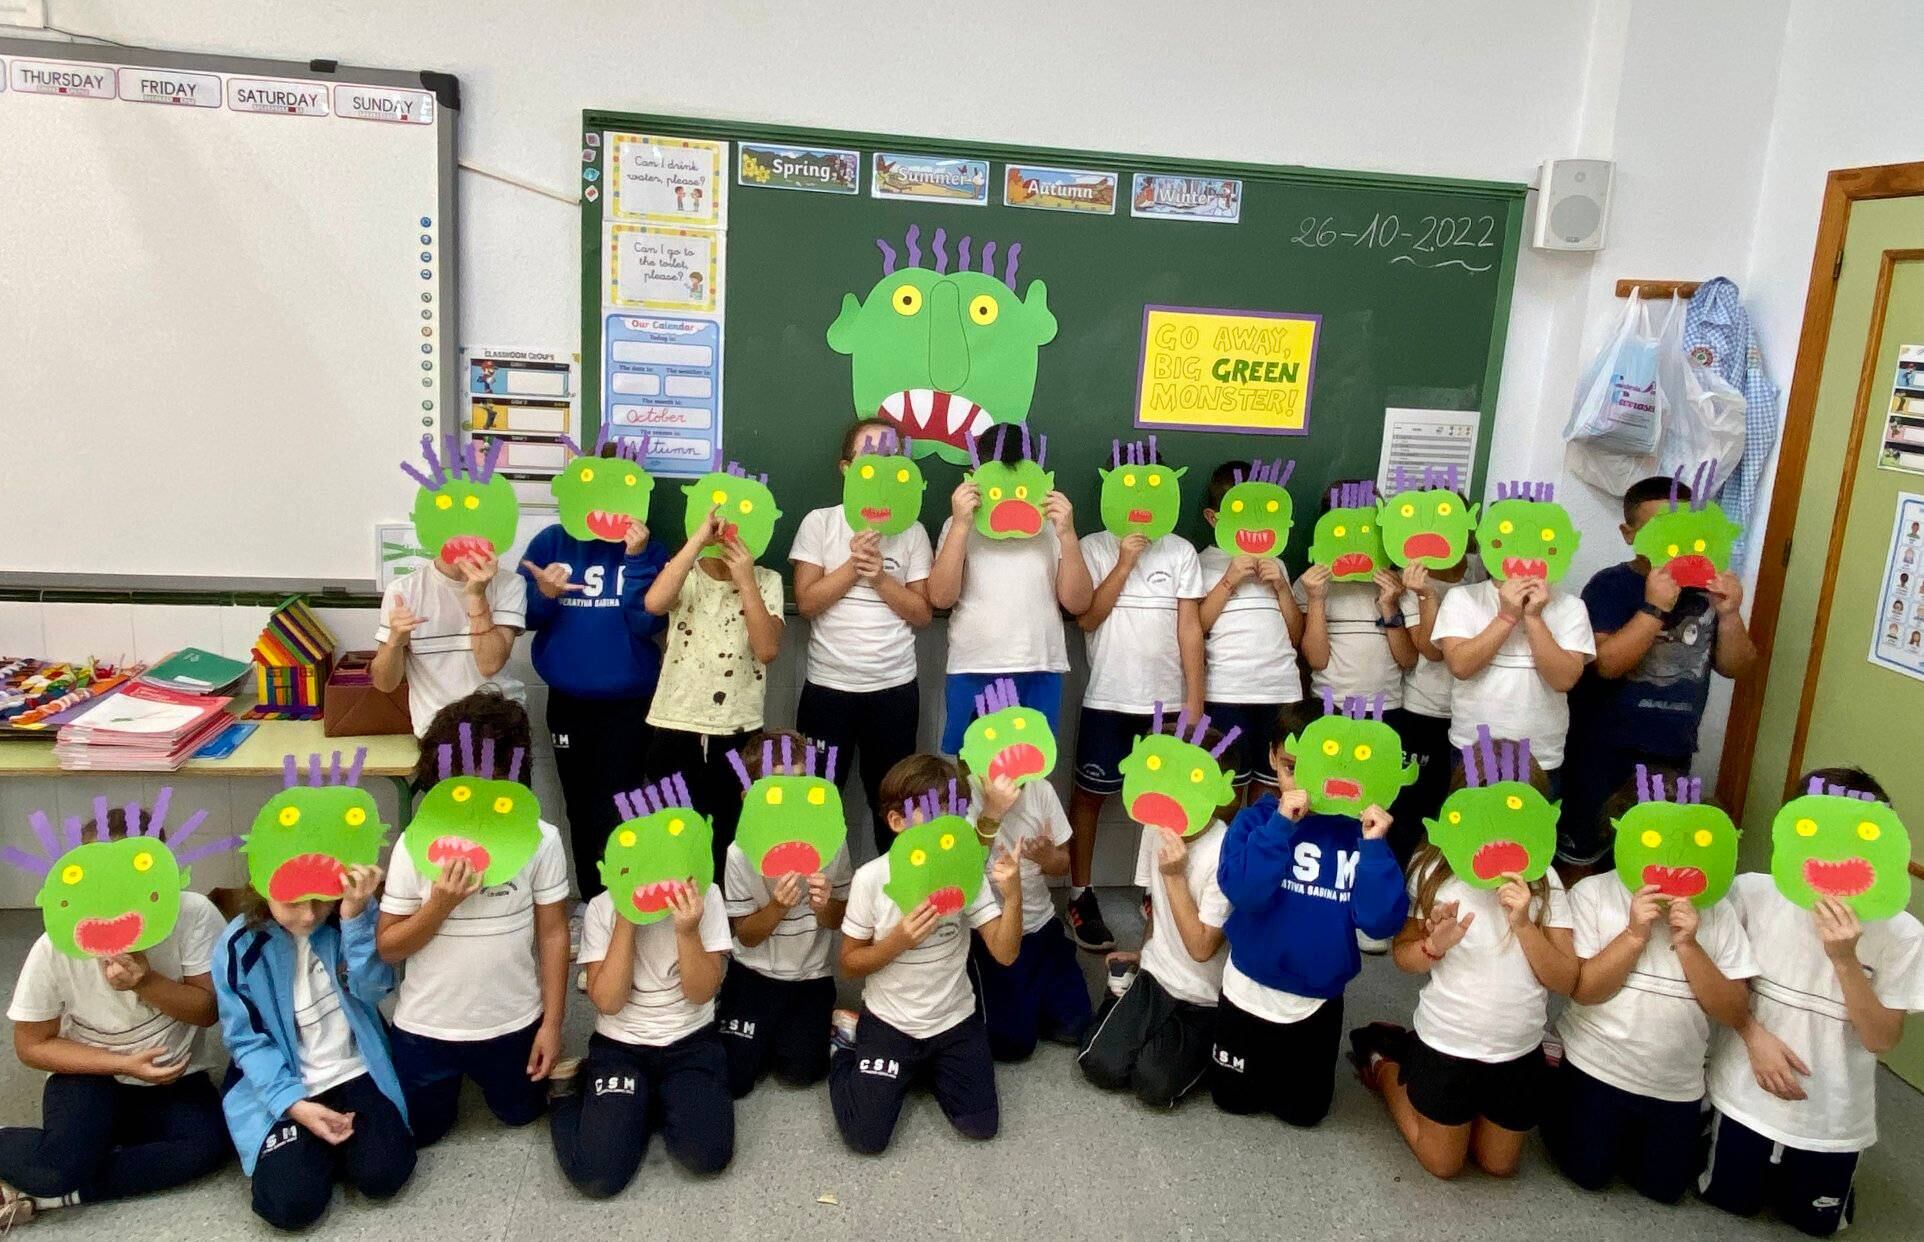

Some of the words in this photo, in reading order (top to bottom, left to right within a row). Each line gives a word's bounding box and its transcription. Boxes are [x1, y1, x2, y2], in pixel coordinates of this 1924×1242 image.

[21, 69, 104, 89] THURSDAY
[141, 79, 197, 97] FRIDAY
[237, 89, 318, 108] SATURDAY
[634, 155, 658, 168] Can
[667, 159, 698, 171] drink
[772, 158, 831, 183] Spring
[666, 174, 706, 187] please?
[898, 167, 966, 185] Summer
[1027, 180, 1094, 199] Autumn
[1159, 189, 1217, 205] Winter
[634, 241, 658, 254] Can
[667, 248, 681, 260] go
[684, 247, 695, 256] to
[639, 256, 656, 267] the
[644, 269, 684, 283] please?
[631, 319, 649, 328] Our
[652, 320, 695, 331] Calendar
[1155, 323, 1199, 351] GO
[1213, 324, 1292, 359] AWAY,
[1153, 352, 1202, 382] BIG
[1211, 357, 1300, 386] GREEN
[1150, 382, 1300, 418] MONSTER!
[626, 407, 687, 424] October
[631, 439, 702, 456] tumn
